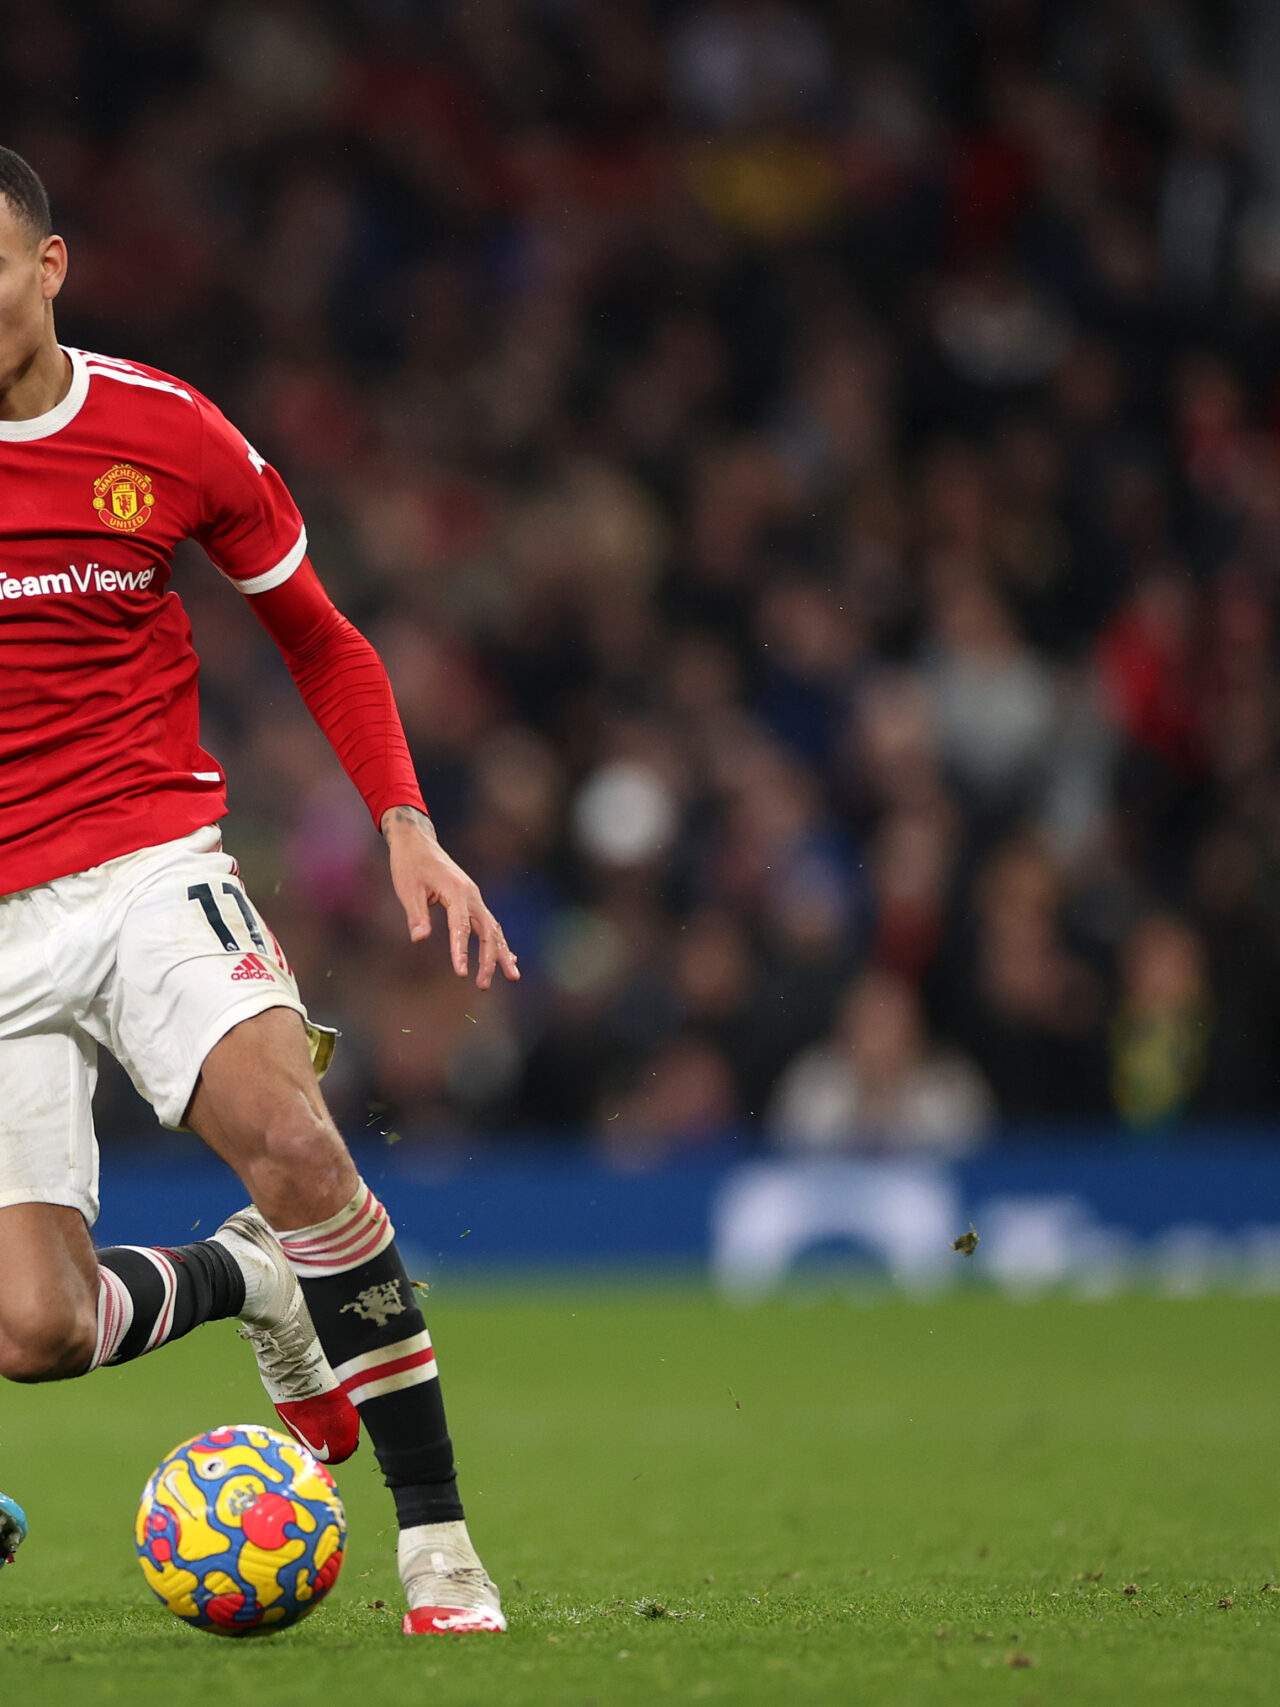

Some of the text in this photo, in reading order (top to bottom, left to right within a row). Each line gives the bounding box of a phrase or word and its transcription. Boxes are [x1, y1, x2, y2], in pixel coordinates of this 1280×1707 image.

[98, 469, 147, 493] MANCHESTER
[109, 515, 143, 529] UNITED
[187, 882, 268, 955] 11
